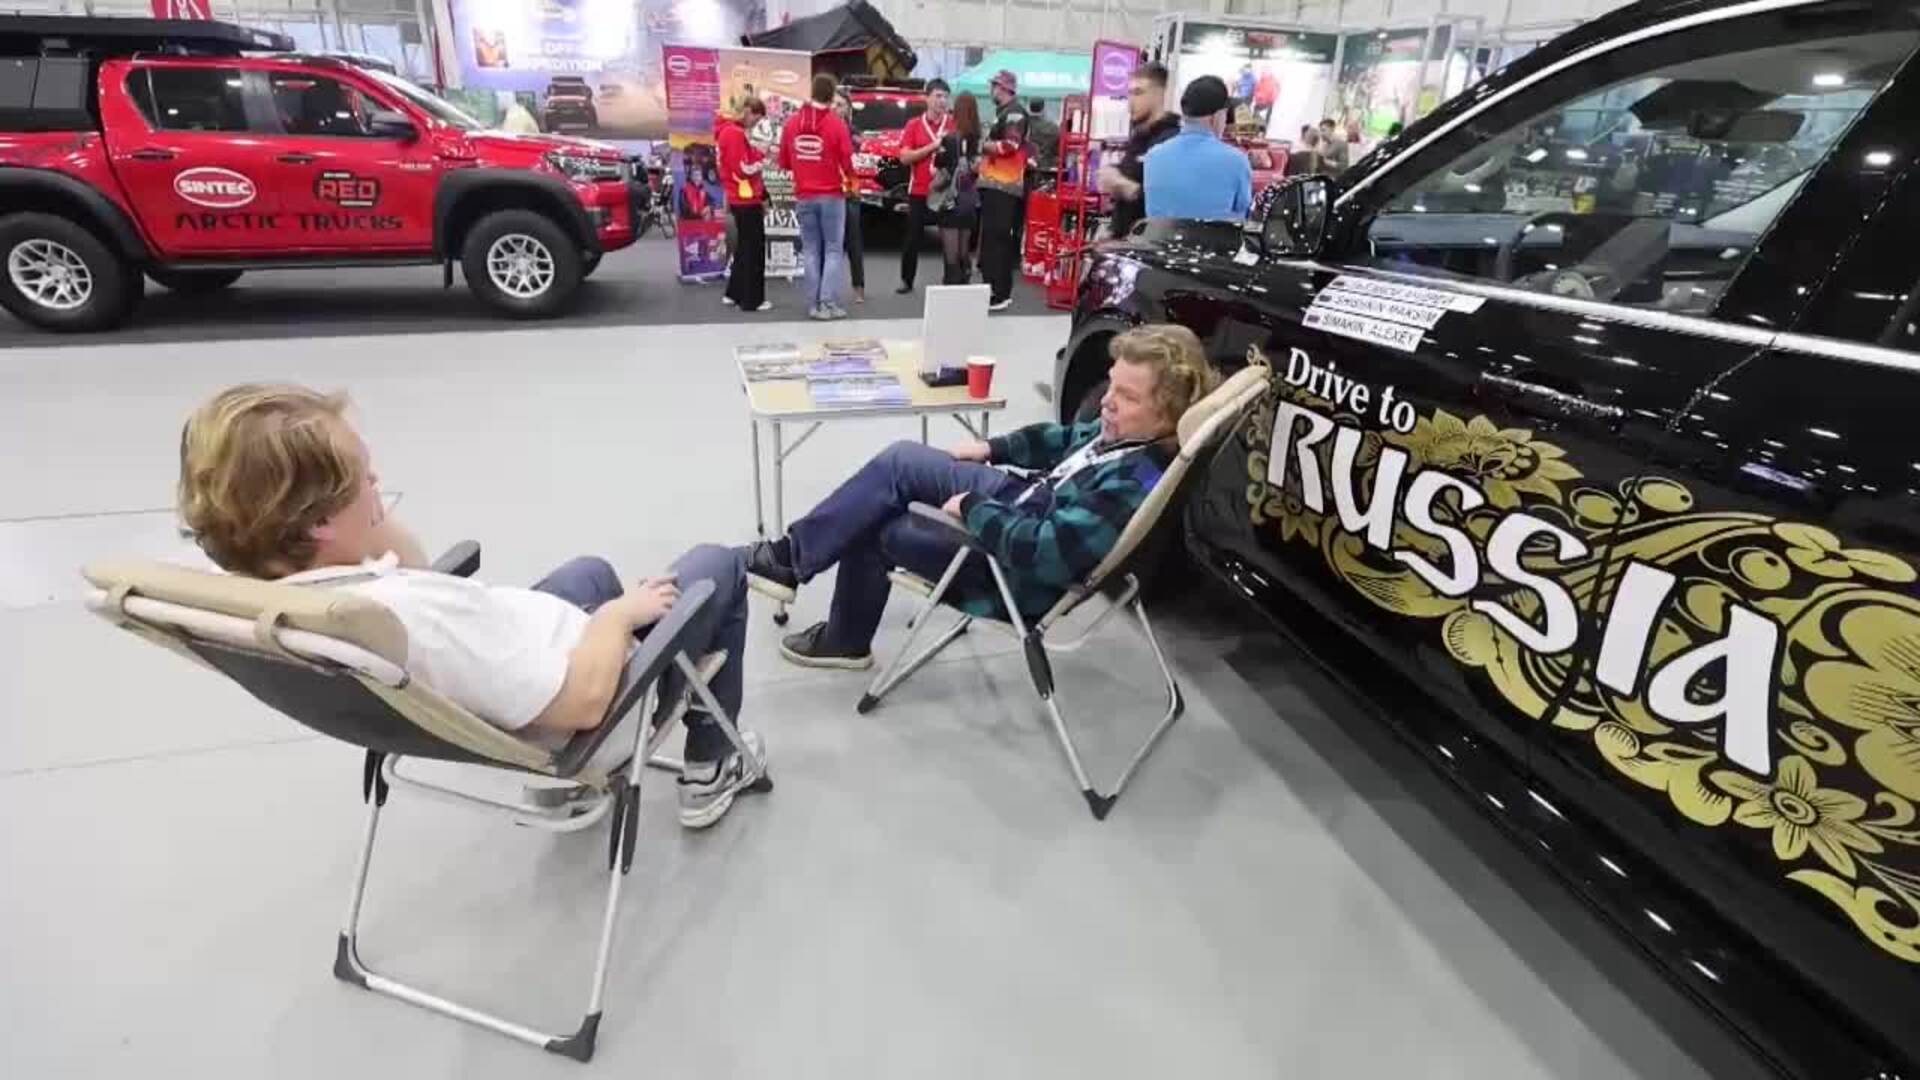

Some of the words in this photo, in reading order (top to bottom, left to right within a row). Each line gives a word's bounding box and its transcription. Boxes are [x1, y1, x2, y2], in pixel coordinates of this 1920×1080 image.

[179, 179, 250, 195] SINTEC
[318, 180, 376, 199] RED
[175, 213, 279, 230] ARCTIC
[296, 213, 402, 230] TRUCKS
[1322, 314, 1366, 334] SIMAKIN
[1368, 324, 1415, 345] ALEXEY
[1284, 347, 1371, 415] Drive
[1378, 386, 1416, 433] to
